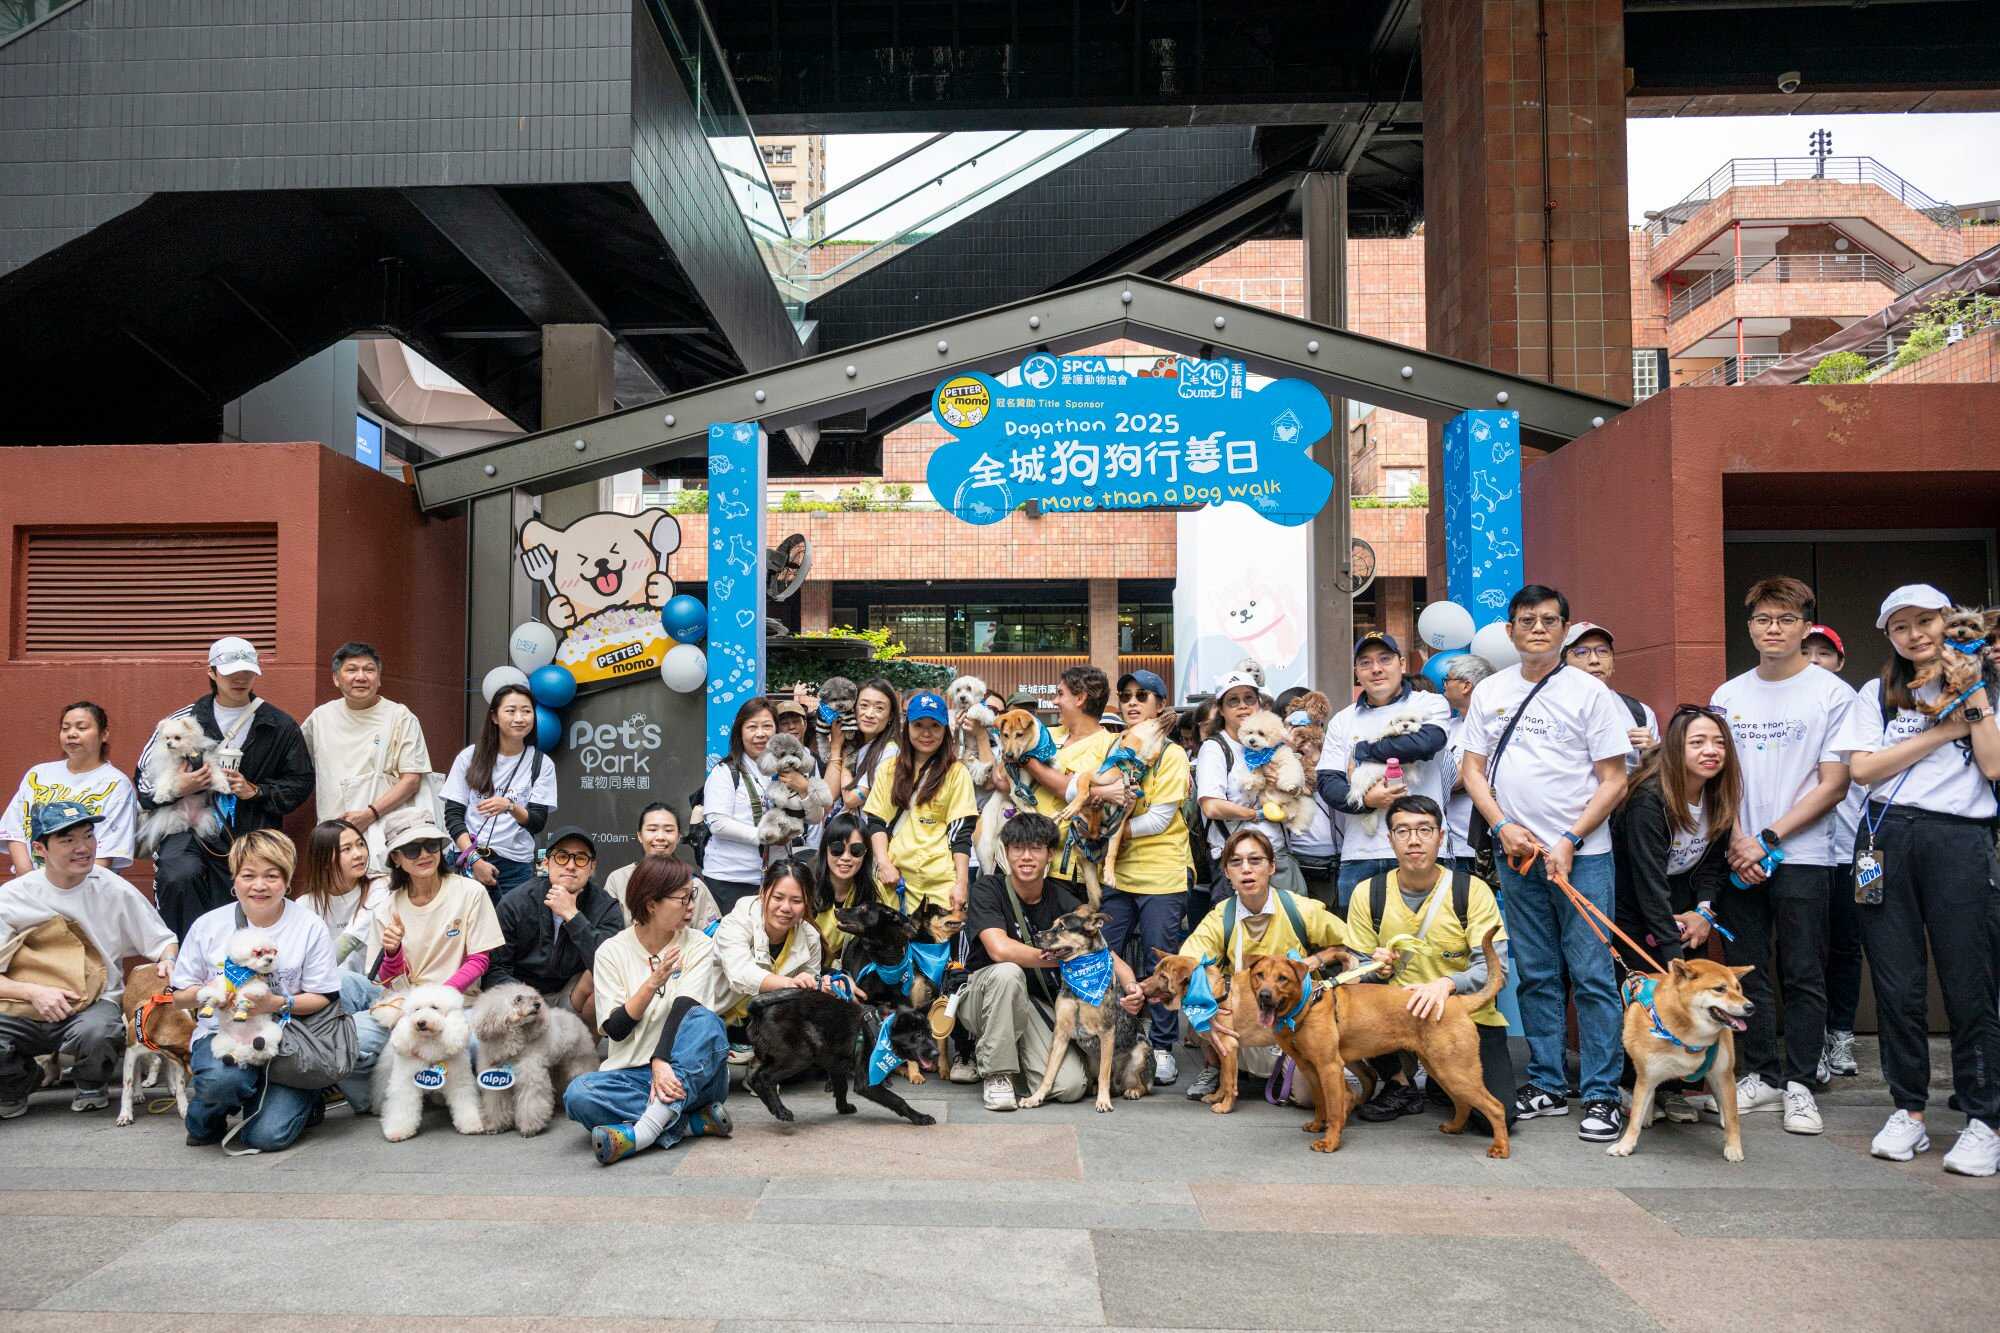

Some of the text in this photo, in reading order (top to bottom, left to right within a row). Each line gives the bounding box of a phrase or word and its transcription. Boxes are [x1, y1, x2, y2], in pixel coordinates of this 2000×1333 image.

[1062, 360, 1106, 372] SPCA
[945, 385, 982, 397] PETTER
[955, 397, 988, 405] momo
[1039, 399, 1060, 408] Title
[1065, 399, 1105, 409] Sponsor
[1005, 412, 1180, 440] Dogathon 2025
[969, 431, 1258, 487] 全城狗狗行善日
[1102, 489, 1158, 505] than
[1164, 489, 1178, 503] a
[1183, 484, 1221, 502] Dog
[598, 643, 643, 667] PETTER
[613, 658, 654, 673] momo
[580, 746, 650, 773] Park
[580, 775, 650, 790] 寵物同樂園
[591, 833, 629, 842] 7:00am
[416, 1072, 441, 1085] nippi
[482, 1074, 510, 1086] nippi
